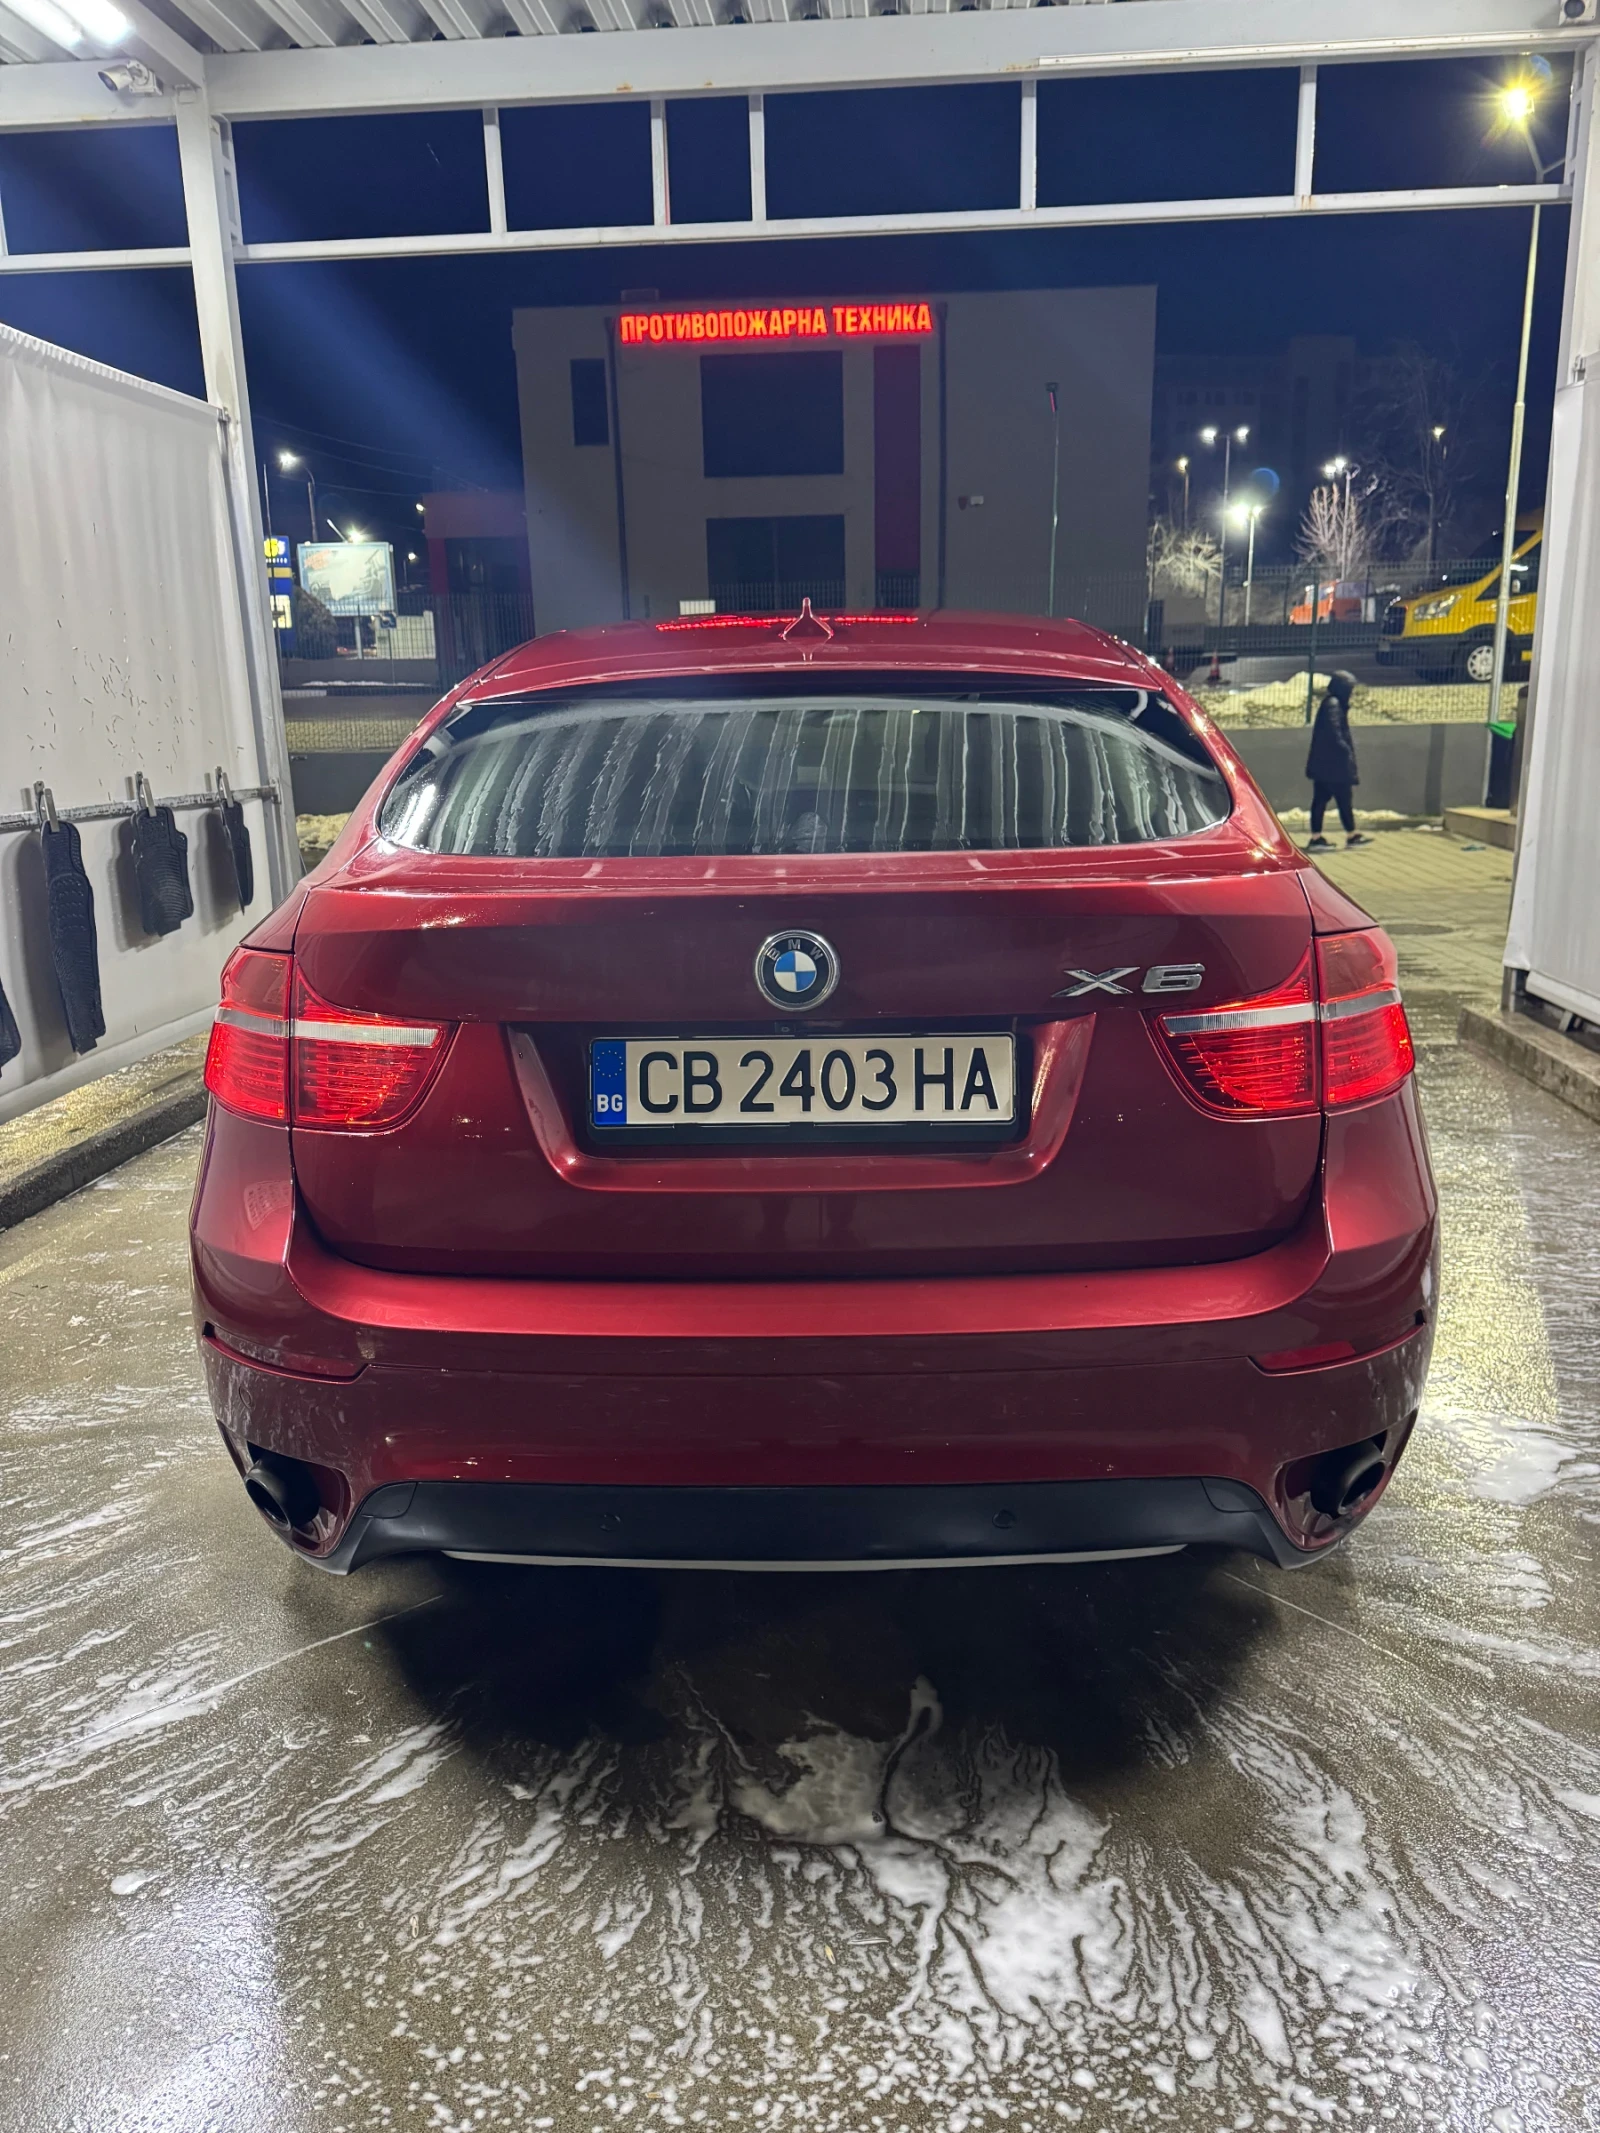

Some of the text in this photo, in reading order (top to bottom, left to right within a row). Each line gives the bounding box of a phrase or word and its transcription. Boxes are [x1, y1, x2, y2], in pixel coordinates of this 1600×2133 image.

[621, 303, 932, 342] ПРОТИВОПОЖАРНА ТЕХНИКА
[766, 939, 823, 961] BMW
[639, 1047, 1000, 1113] CB 2403 HA
[597, 1093, 624, 1113] BG
